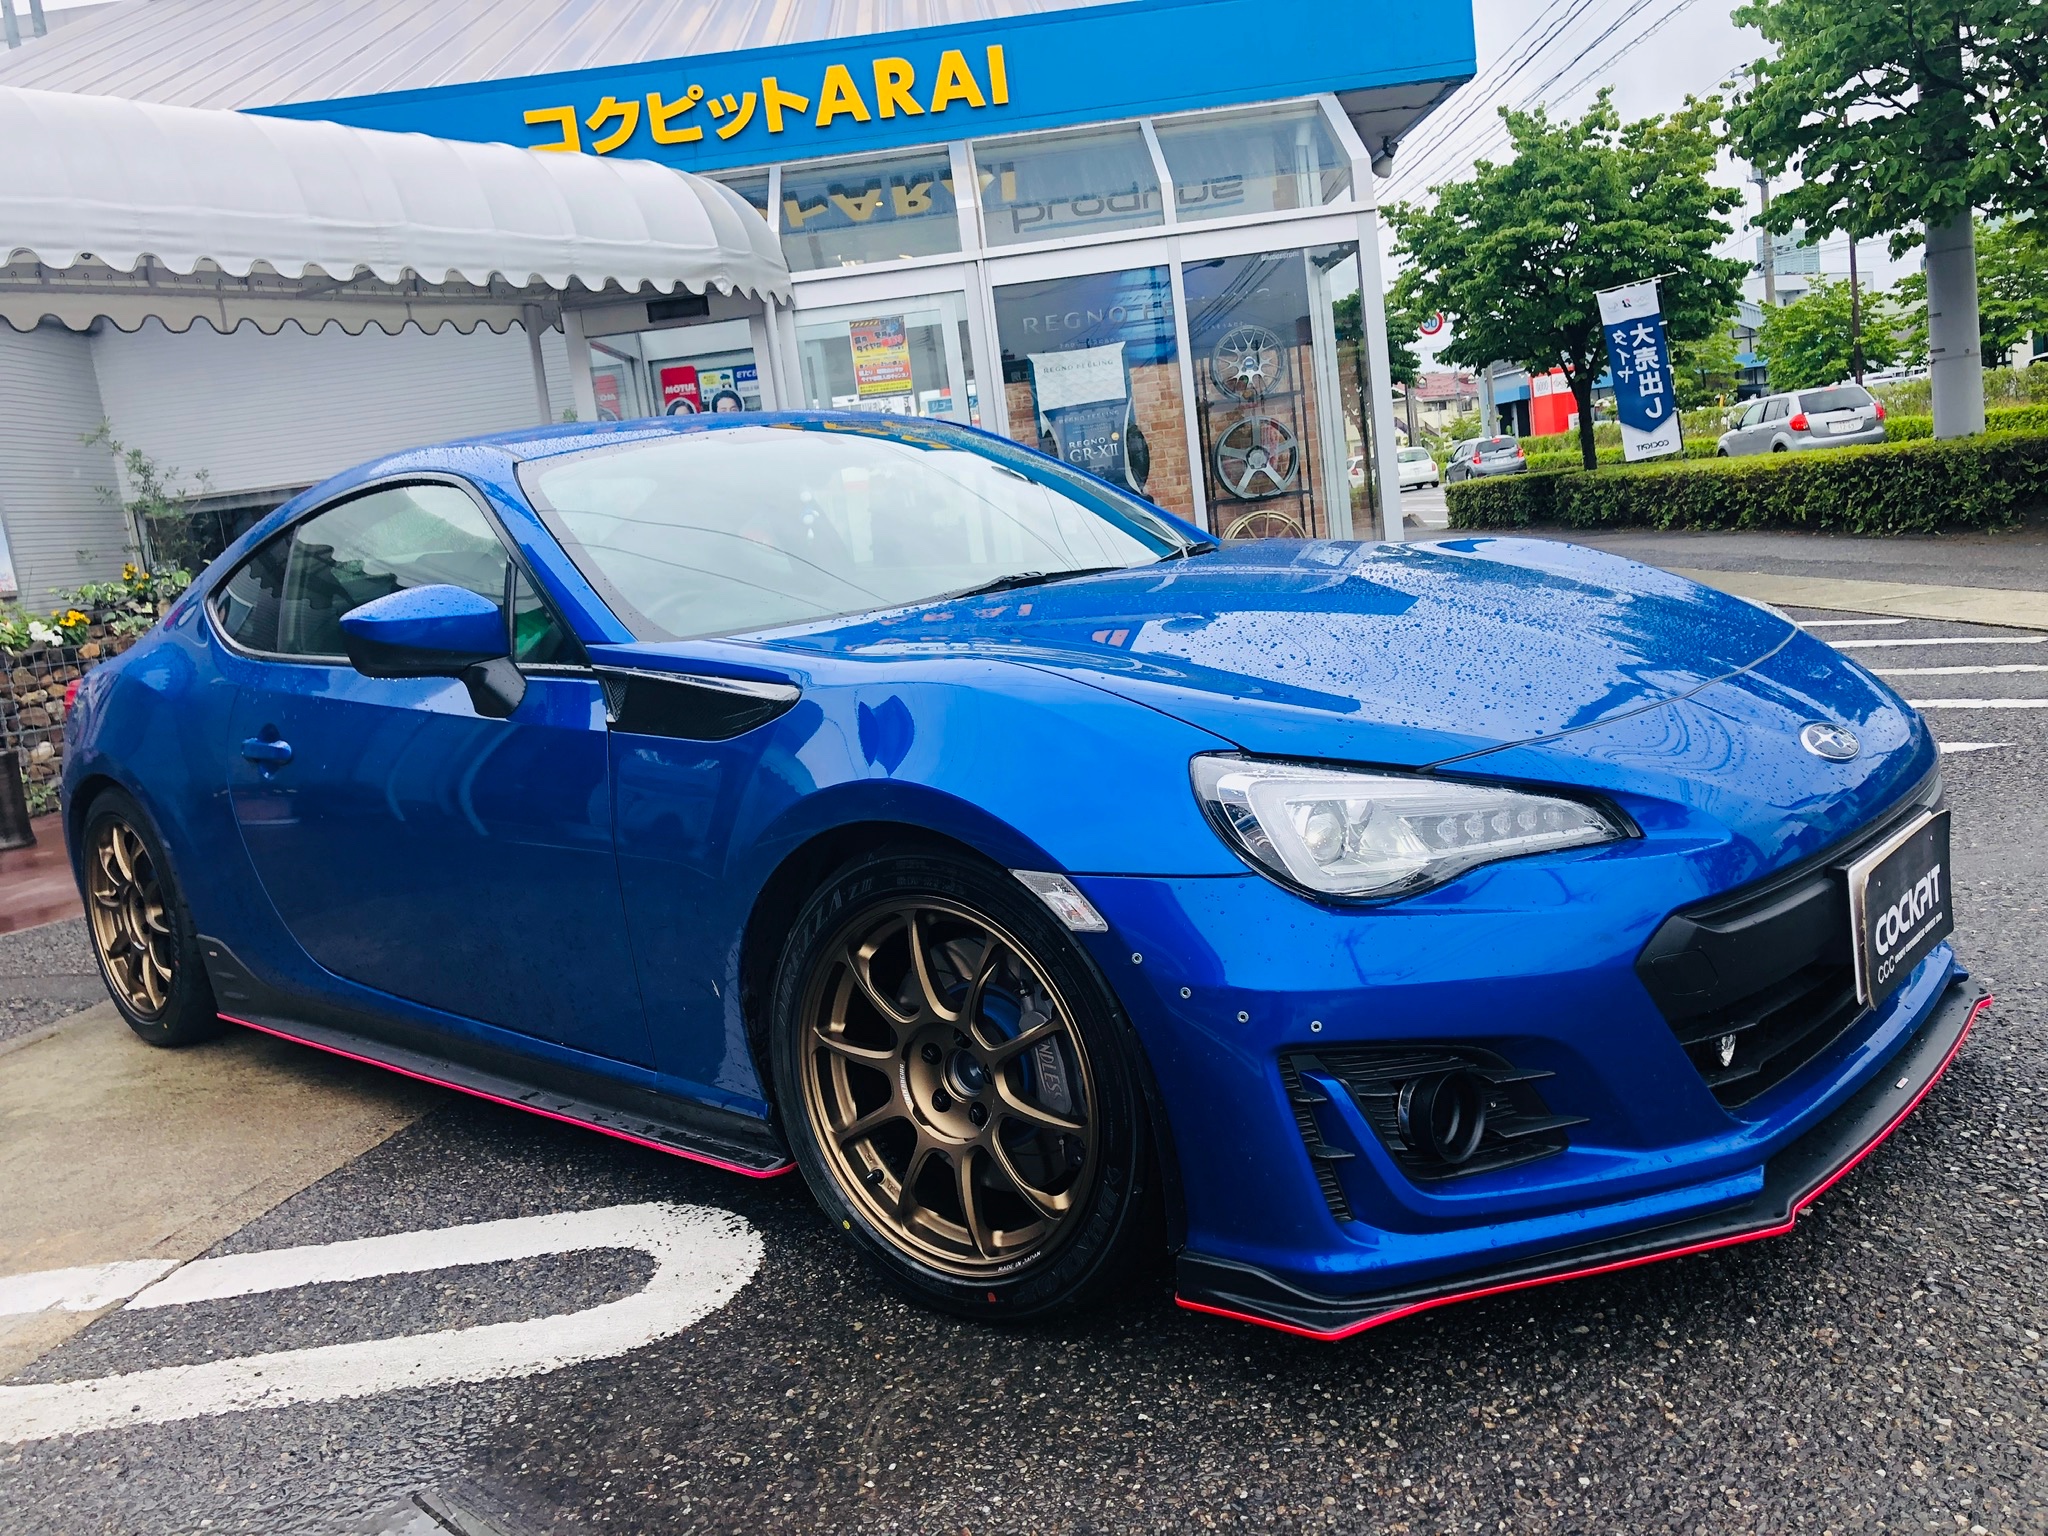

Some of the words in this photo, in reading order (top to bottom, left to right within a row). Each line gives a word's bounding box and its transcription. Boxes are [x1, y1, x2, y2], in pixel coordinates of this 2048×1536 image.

[1023, 306, 1128, 335] REGNO
[1043, 364, 1074, 374] REGNO
[1076, 360, 1114, 369] FEELING
[665, 382, 696, 394] MOTUL
[1068, 437, 1106, 448] REGNO
[1875, 863, 1941, 956] COCKPIT
[1877, 954, 1895, 984] CCC
